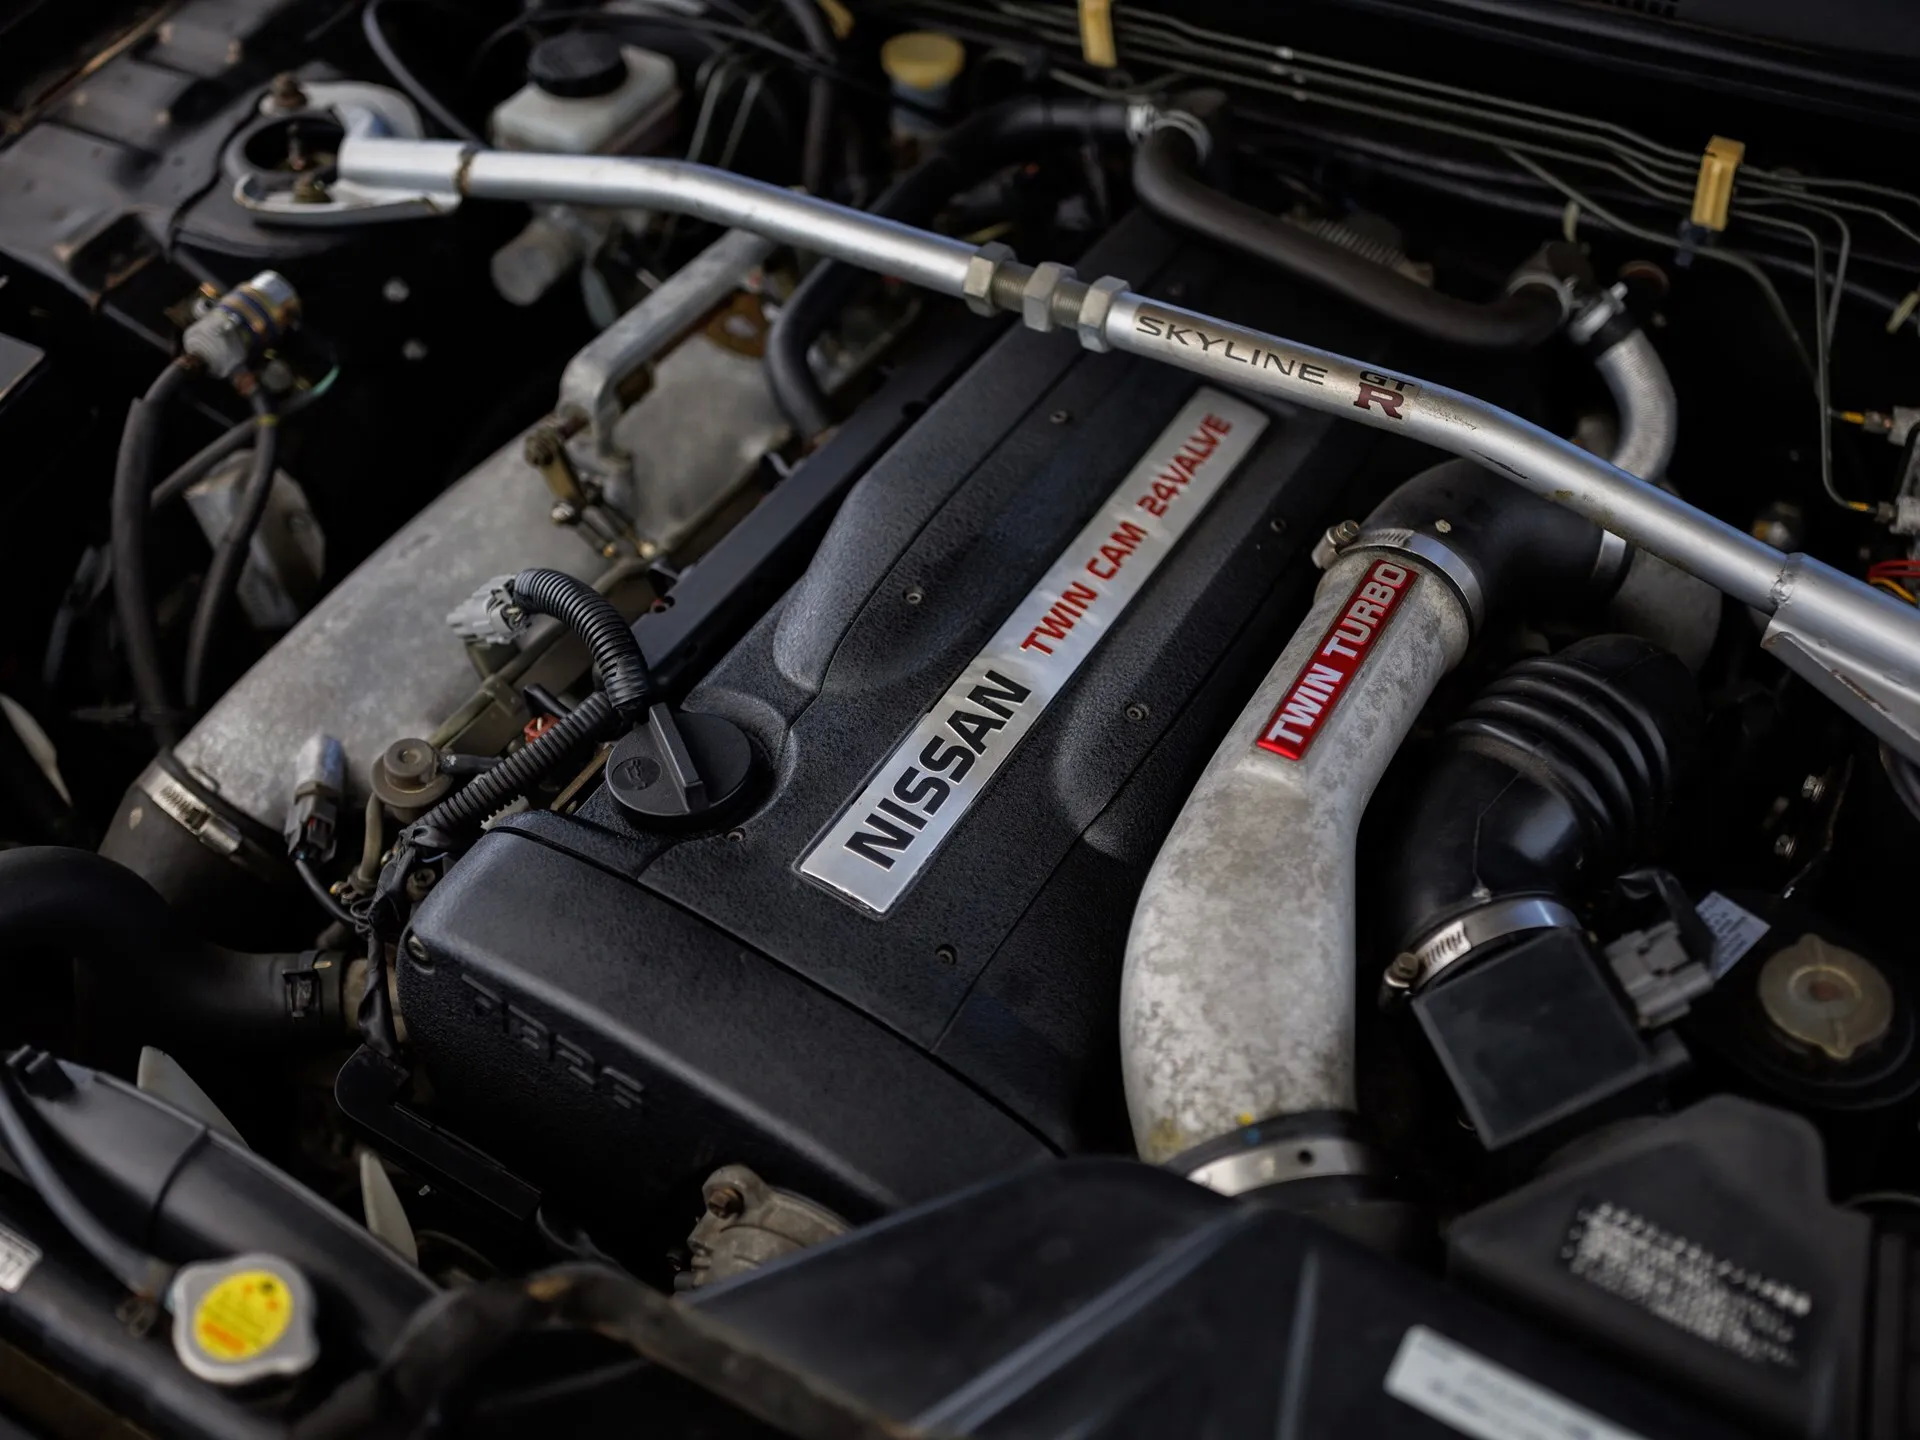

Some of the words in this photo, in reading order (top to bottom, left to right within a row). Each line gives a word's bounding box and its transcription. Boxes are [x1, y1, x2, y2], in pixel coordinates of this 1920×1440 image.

[1136, 315, 1329, 386] SKYLINE
[1359, 370, 1415, 391] GT
[1353, 382, 1404, 420] R
[843, 669, 1034, 873] NISSAN
[1020, 582, 1098, 656] TWIN
[1087, 521, 1149, 581] CAM
[1137, 413, 1234, 518] 24VALVE
[1265, 663, 1344, 745] TWIN
[1321, 562, 1408, 661] TURBO
